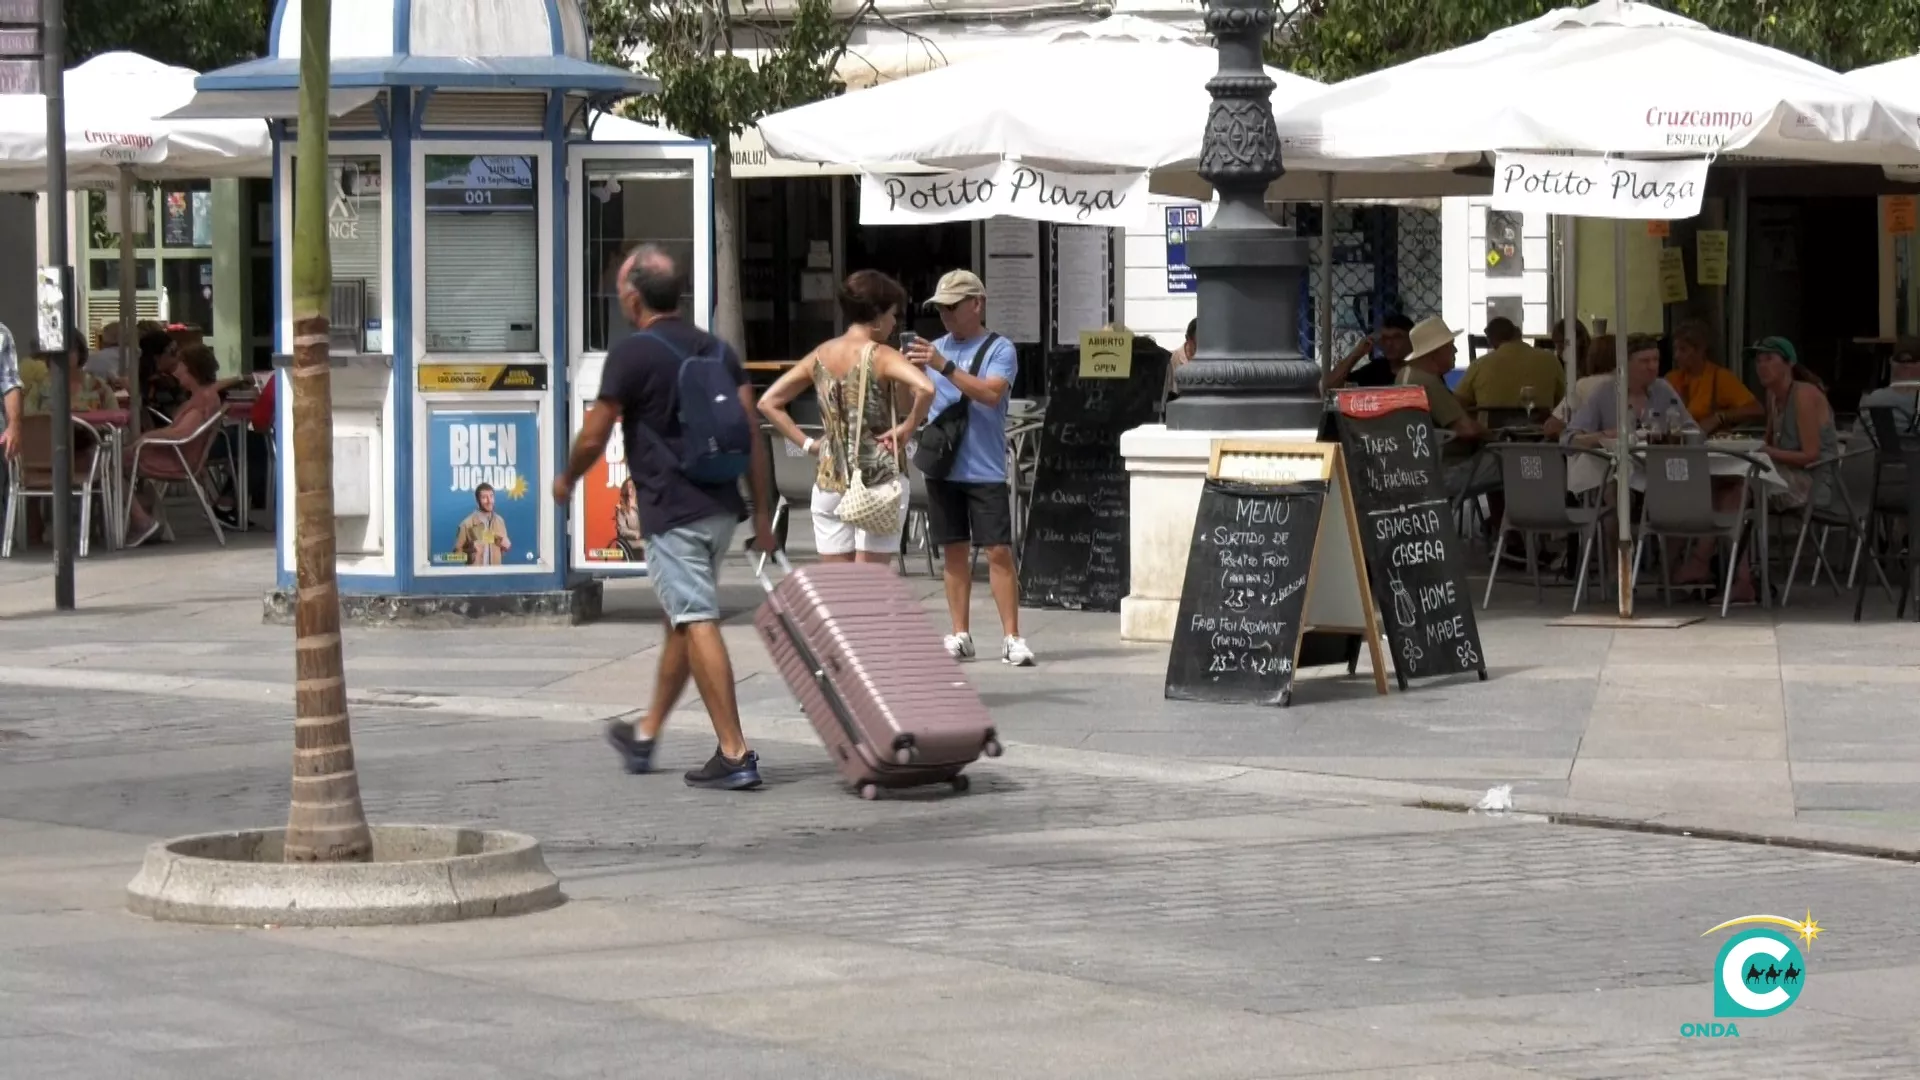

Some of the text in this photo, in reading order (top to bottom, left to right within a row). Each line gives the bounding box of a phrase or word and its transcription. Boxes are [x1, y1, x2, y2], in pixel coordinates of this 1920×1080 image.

[1646, 106, 1753, 130] Cruzcampo
[84, 129, 153, 149] Cruzcampo
[1666, 133, 1728, 146] ESPECIAL
[465, 190, 492, 204] 001
[885, 167, 1126, 220] Potito Plaza
[1504, 163, 1695, 208] Potito Plaza
[329, 222, 359, 239] NCE
[1088, 336, 1125, 347] ABIERTO
[1094, 363, 1117, 373] OPEN
[449, 424, 517, 465] BIEN
[1360, 434, 1398, 455] TAPAS
[450, 465, 517, 492] JUGADO
[1376, 510, 1440, 540] SANGRIA
[1272, 532, 1290, 545] DE
[1392, 540, 1445, 567] CASERA
[1419, 580, 1455, 614] HOME
[1426, 615, 1465, 647] MADE
